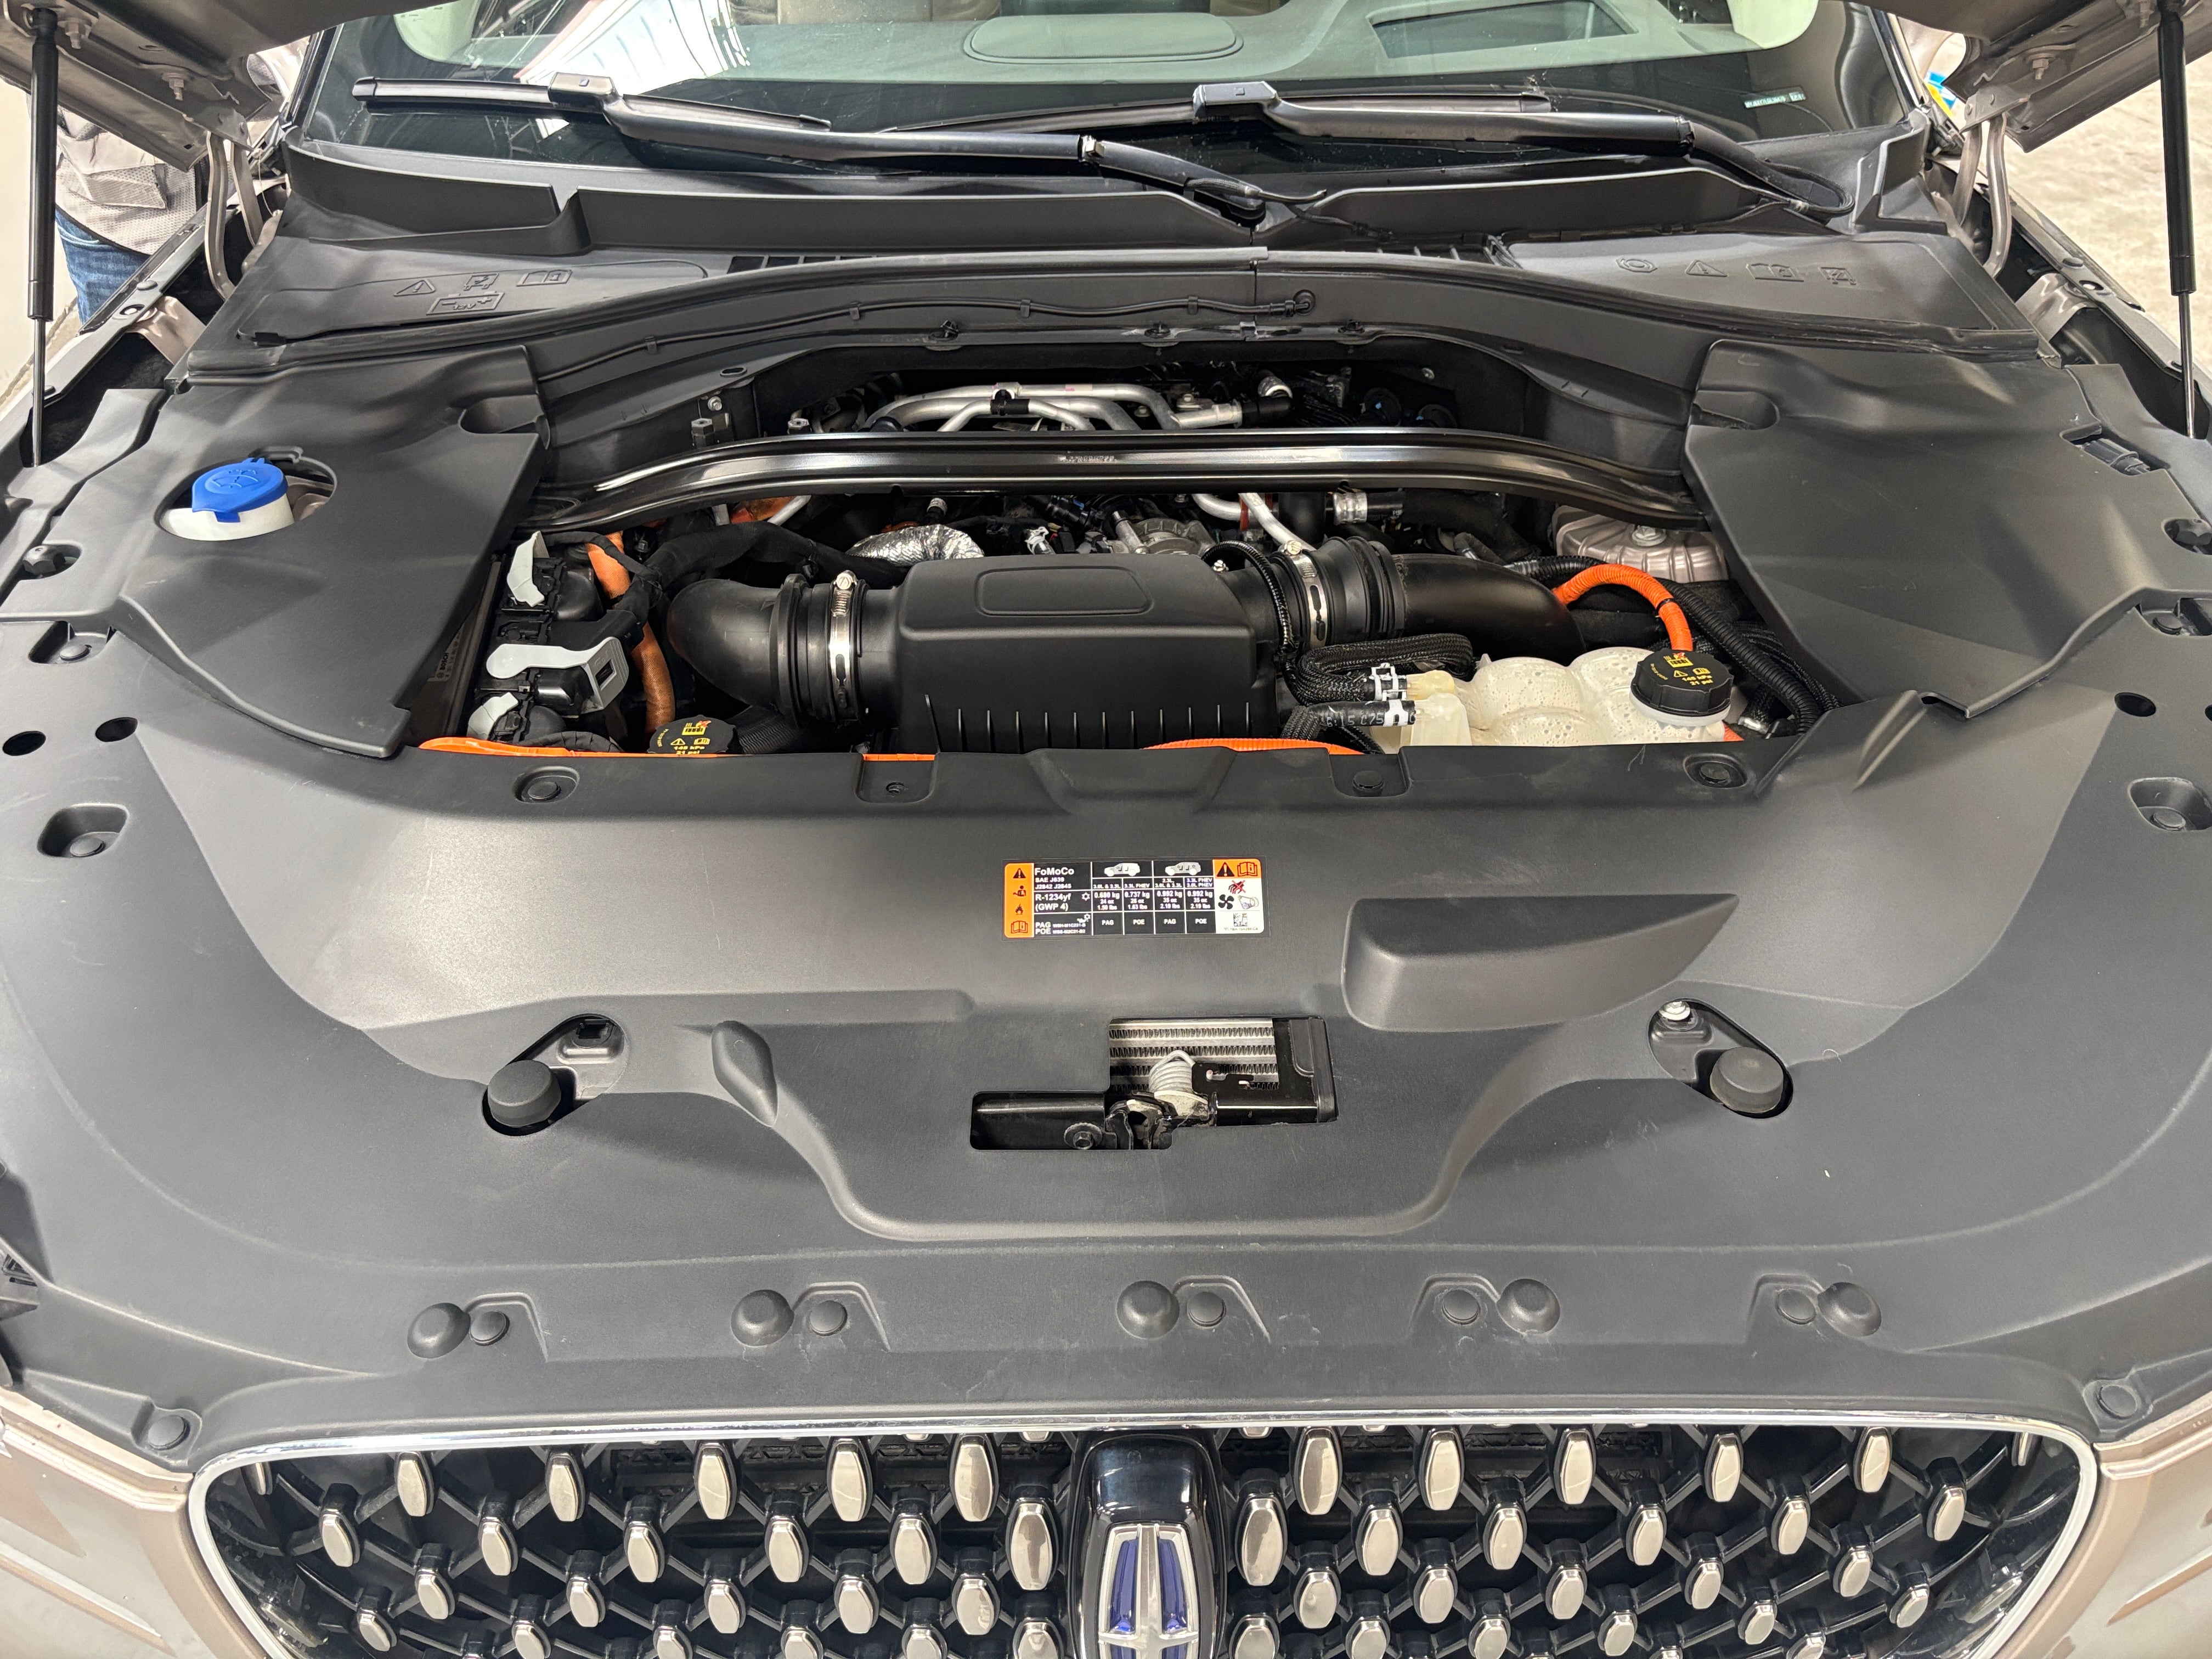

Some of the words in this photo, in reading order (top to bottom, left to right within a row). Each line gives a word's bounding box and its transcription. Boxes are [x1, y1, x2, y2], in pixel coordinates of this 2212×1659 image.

[439, 653, 449, 670] BOSCH
[1034, 867, 1075, 876] FoMoCo
[1035, 893, 1072, 902] R-1234yf
[1142, 891, 1150, 899] kg
[1174, 890, 1183, 898] kg
[1205, 890, 1213, 898] kg
[1035, 903, 1059, 912] (GWP
[1060, 902, 1069, 912] 4)
